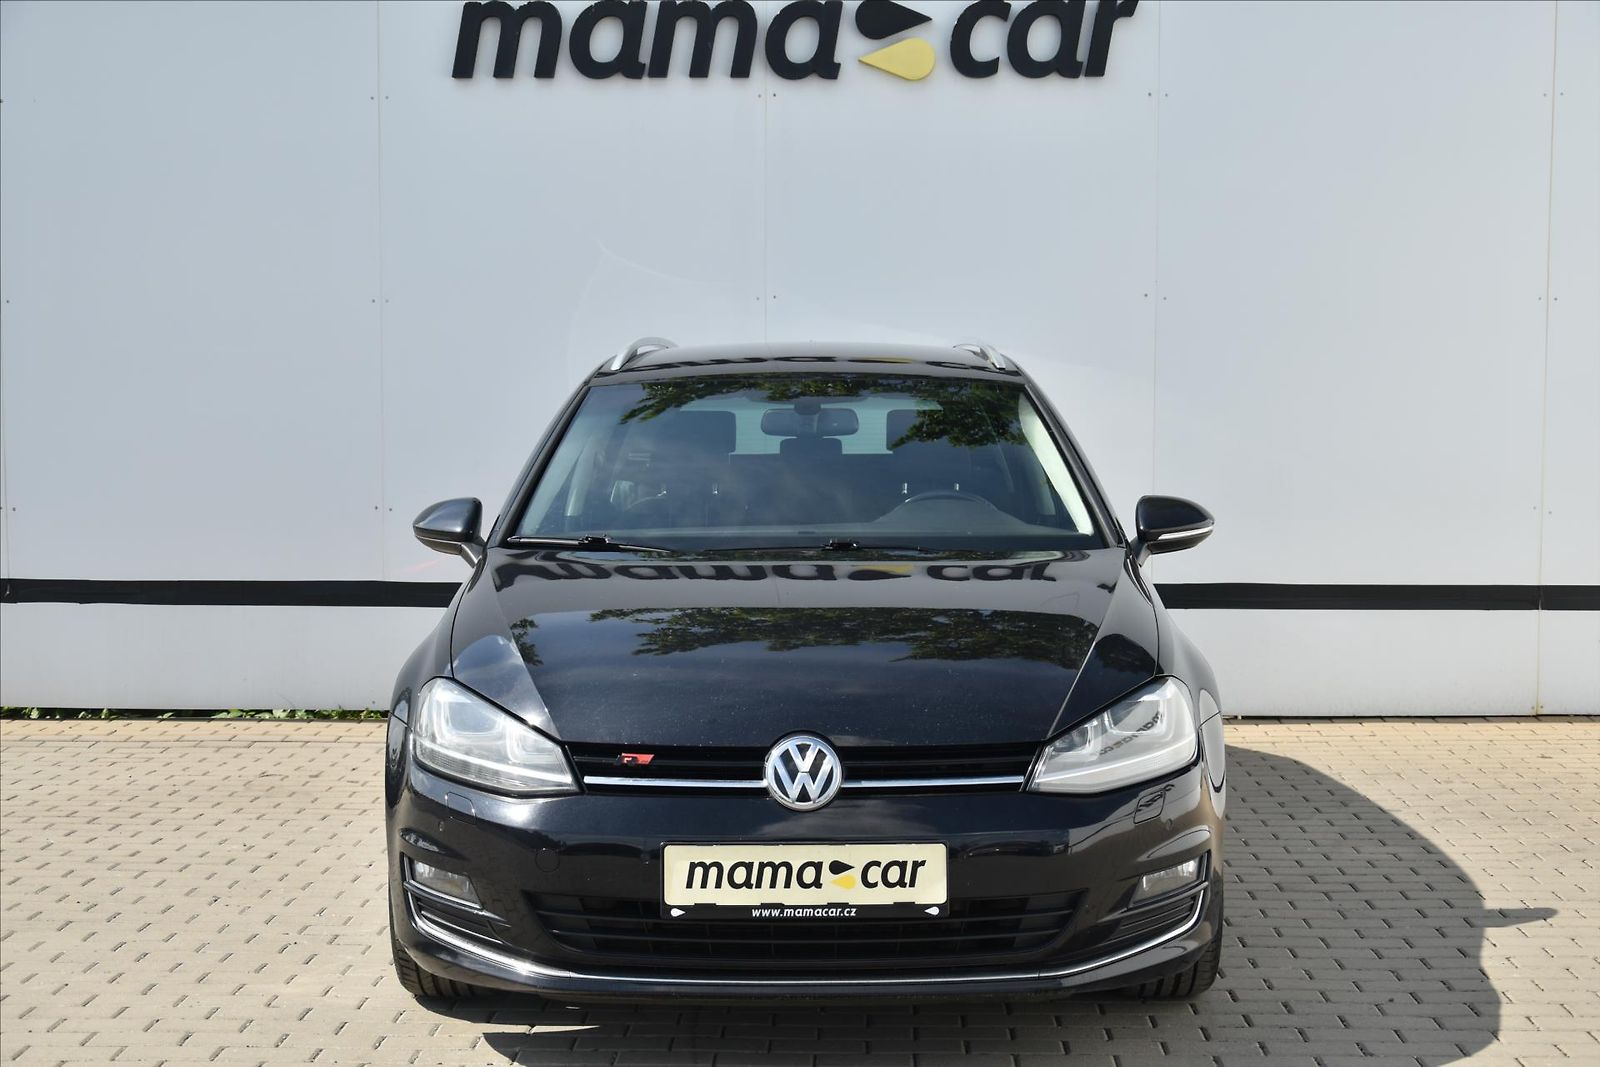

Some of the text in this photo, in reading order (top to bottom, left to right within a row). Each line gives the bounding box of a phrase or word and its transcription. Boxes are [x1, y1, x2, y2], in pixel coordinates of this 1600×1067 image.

[452, 0, 1139, 80] mama car
[685, 859, 927, 890] mama car
[752, 906, 857, 918] www.mamacar.cz
